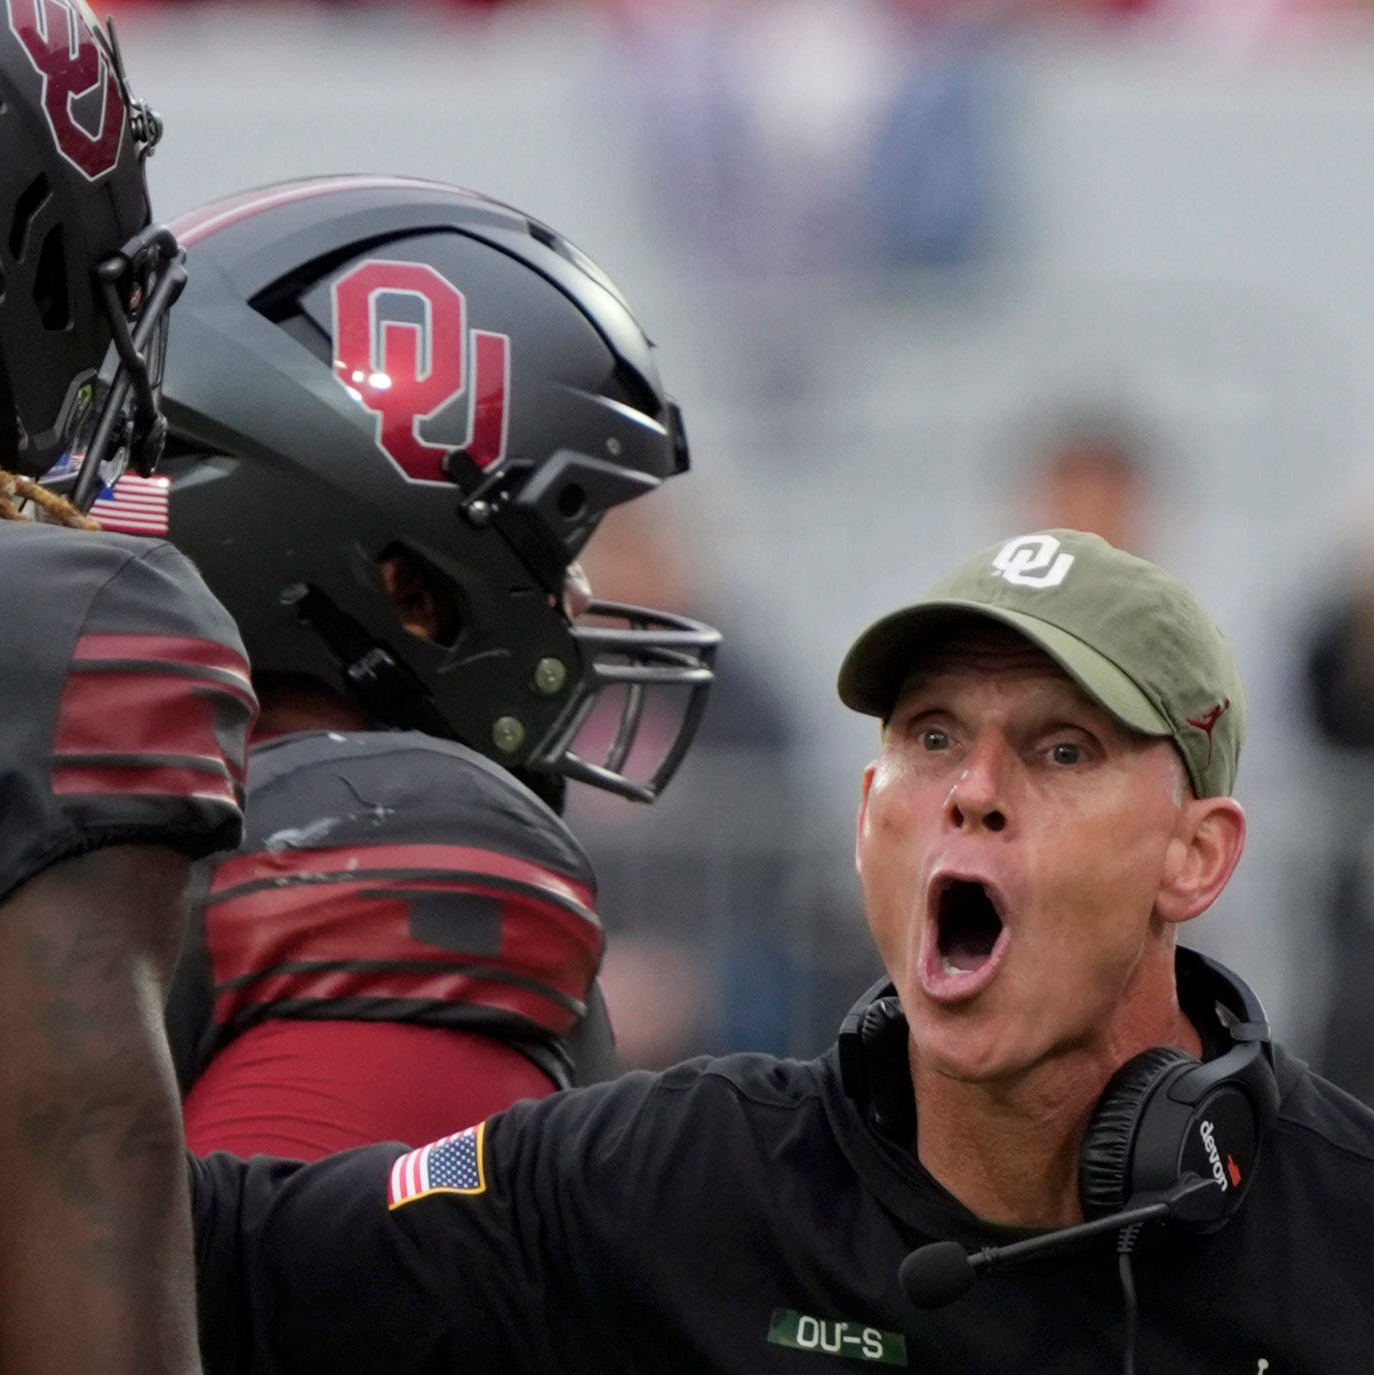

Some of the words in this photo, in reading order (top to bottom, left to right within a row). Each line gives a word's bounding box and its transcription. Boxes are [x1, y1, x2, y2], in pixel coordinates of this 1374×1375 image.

[331, 258, 510, 487] OU
[991, 533, 1075, 589] OU
[1200, 1120, 1229, 1192] devon
